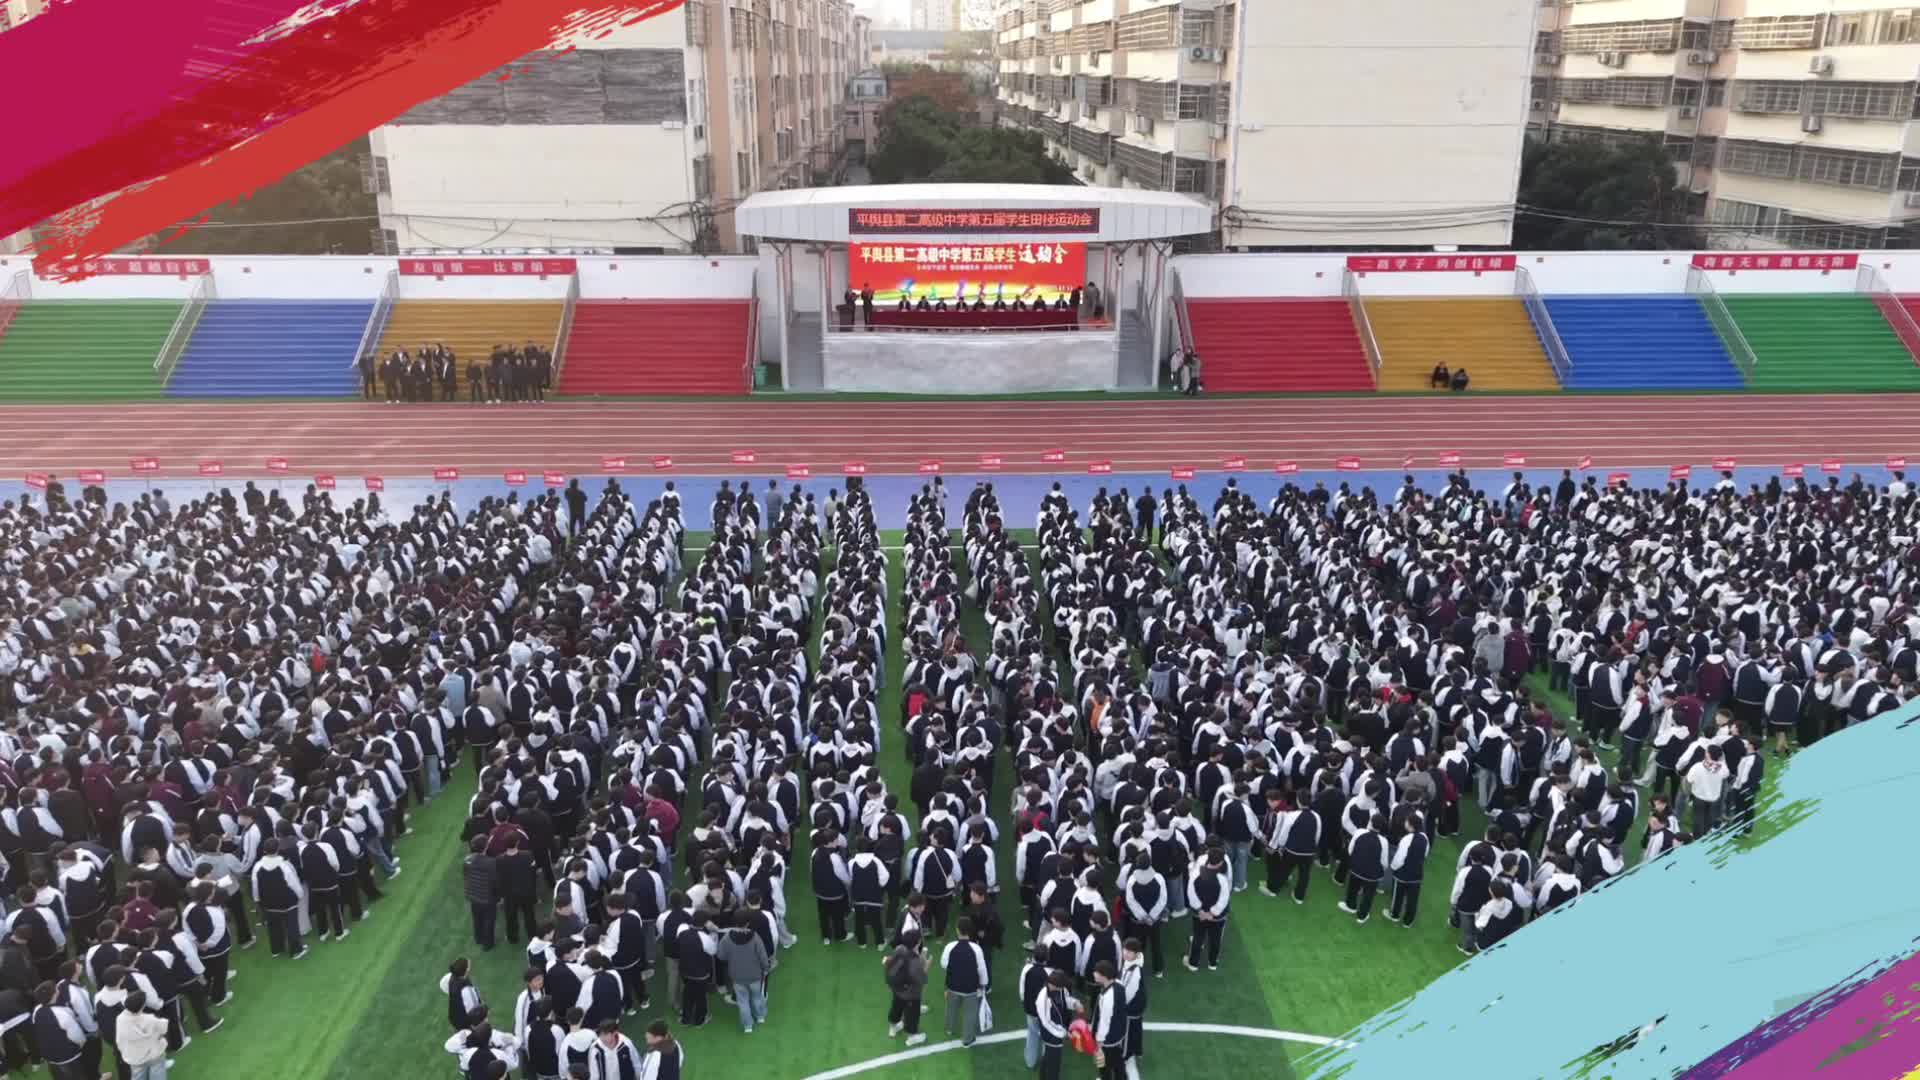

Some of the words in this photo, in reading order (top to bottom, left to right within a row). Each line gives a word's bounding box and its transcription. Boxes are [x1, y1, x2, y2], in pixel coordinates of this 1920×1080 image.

[857, 213, 1092, 226] 平舆县第二高级中学第五届学生田径运动会
